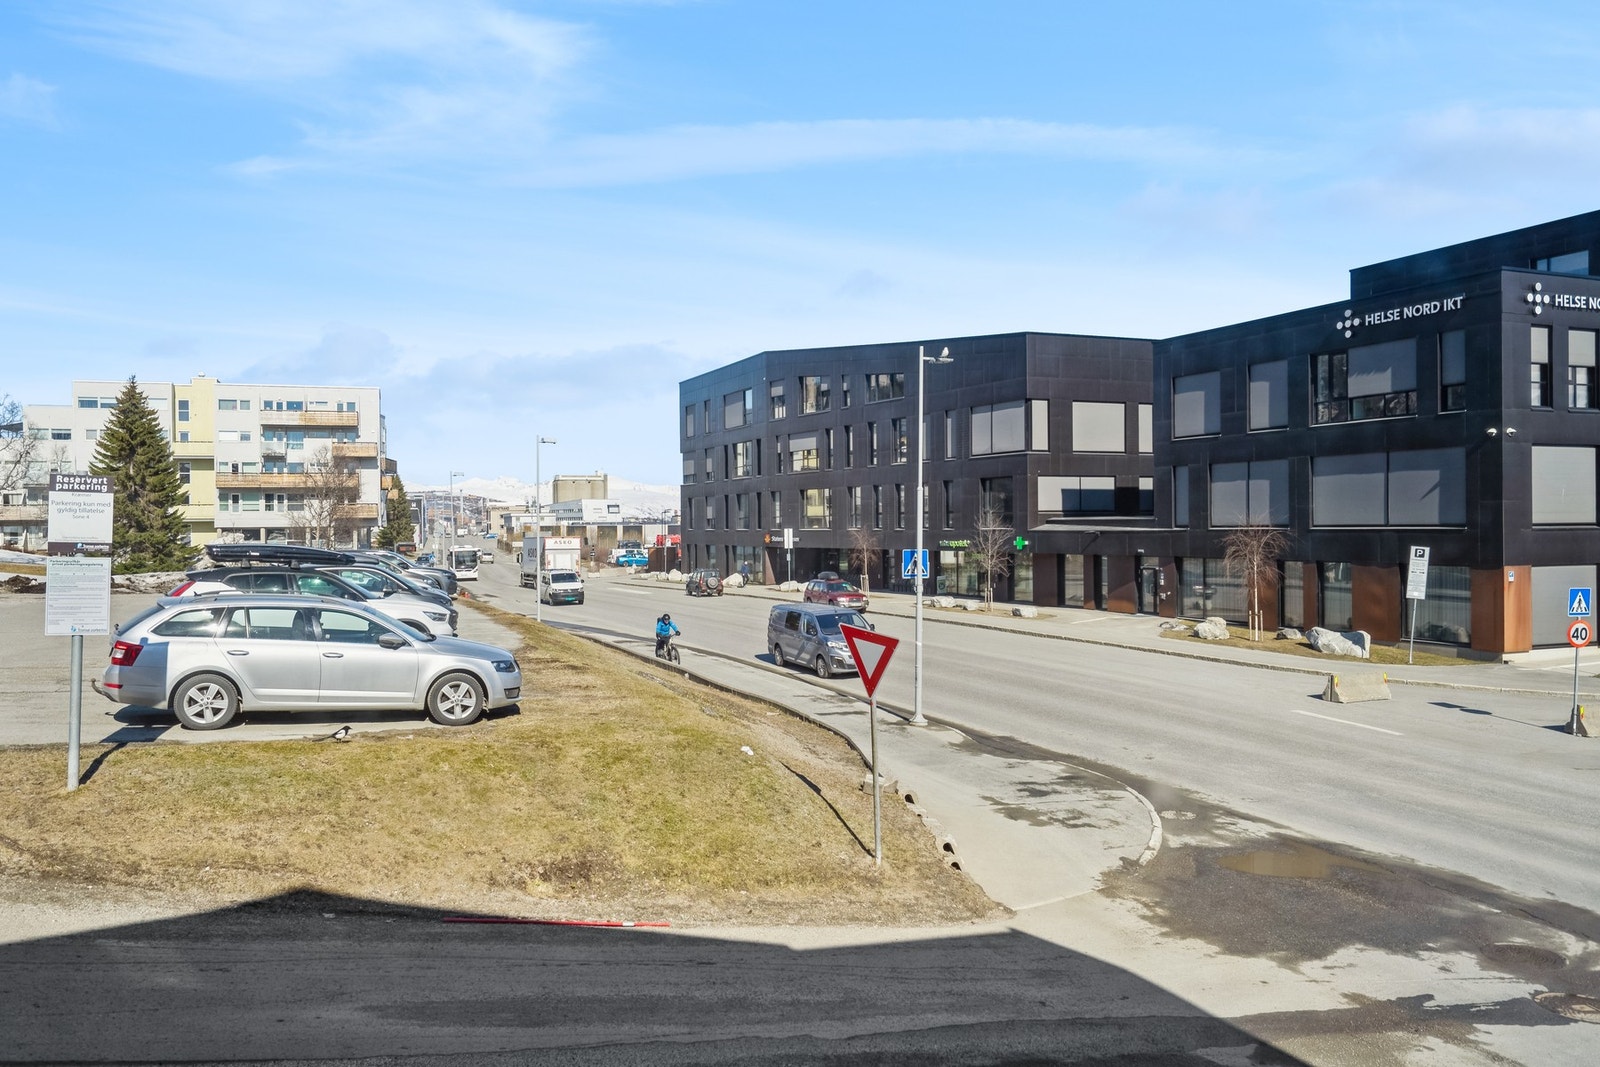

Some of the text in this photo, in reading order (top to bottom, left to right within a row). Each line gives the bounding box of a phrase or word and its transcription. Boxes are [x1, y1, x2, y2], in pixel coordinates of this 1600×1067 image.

[1555, 294, 1587, 309] HELSE
[1365, 296, 1463, 326] HELSE NORD IKT
[56, 475, 108, 484] Reservert
[55, 482, 108, 493] parkering
[1571, 627, 1588, 641] 40
